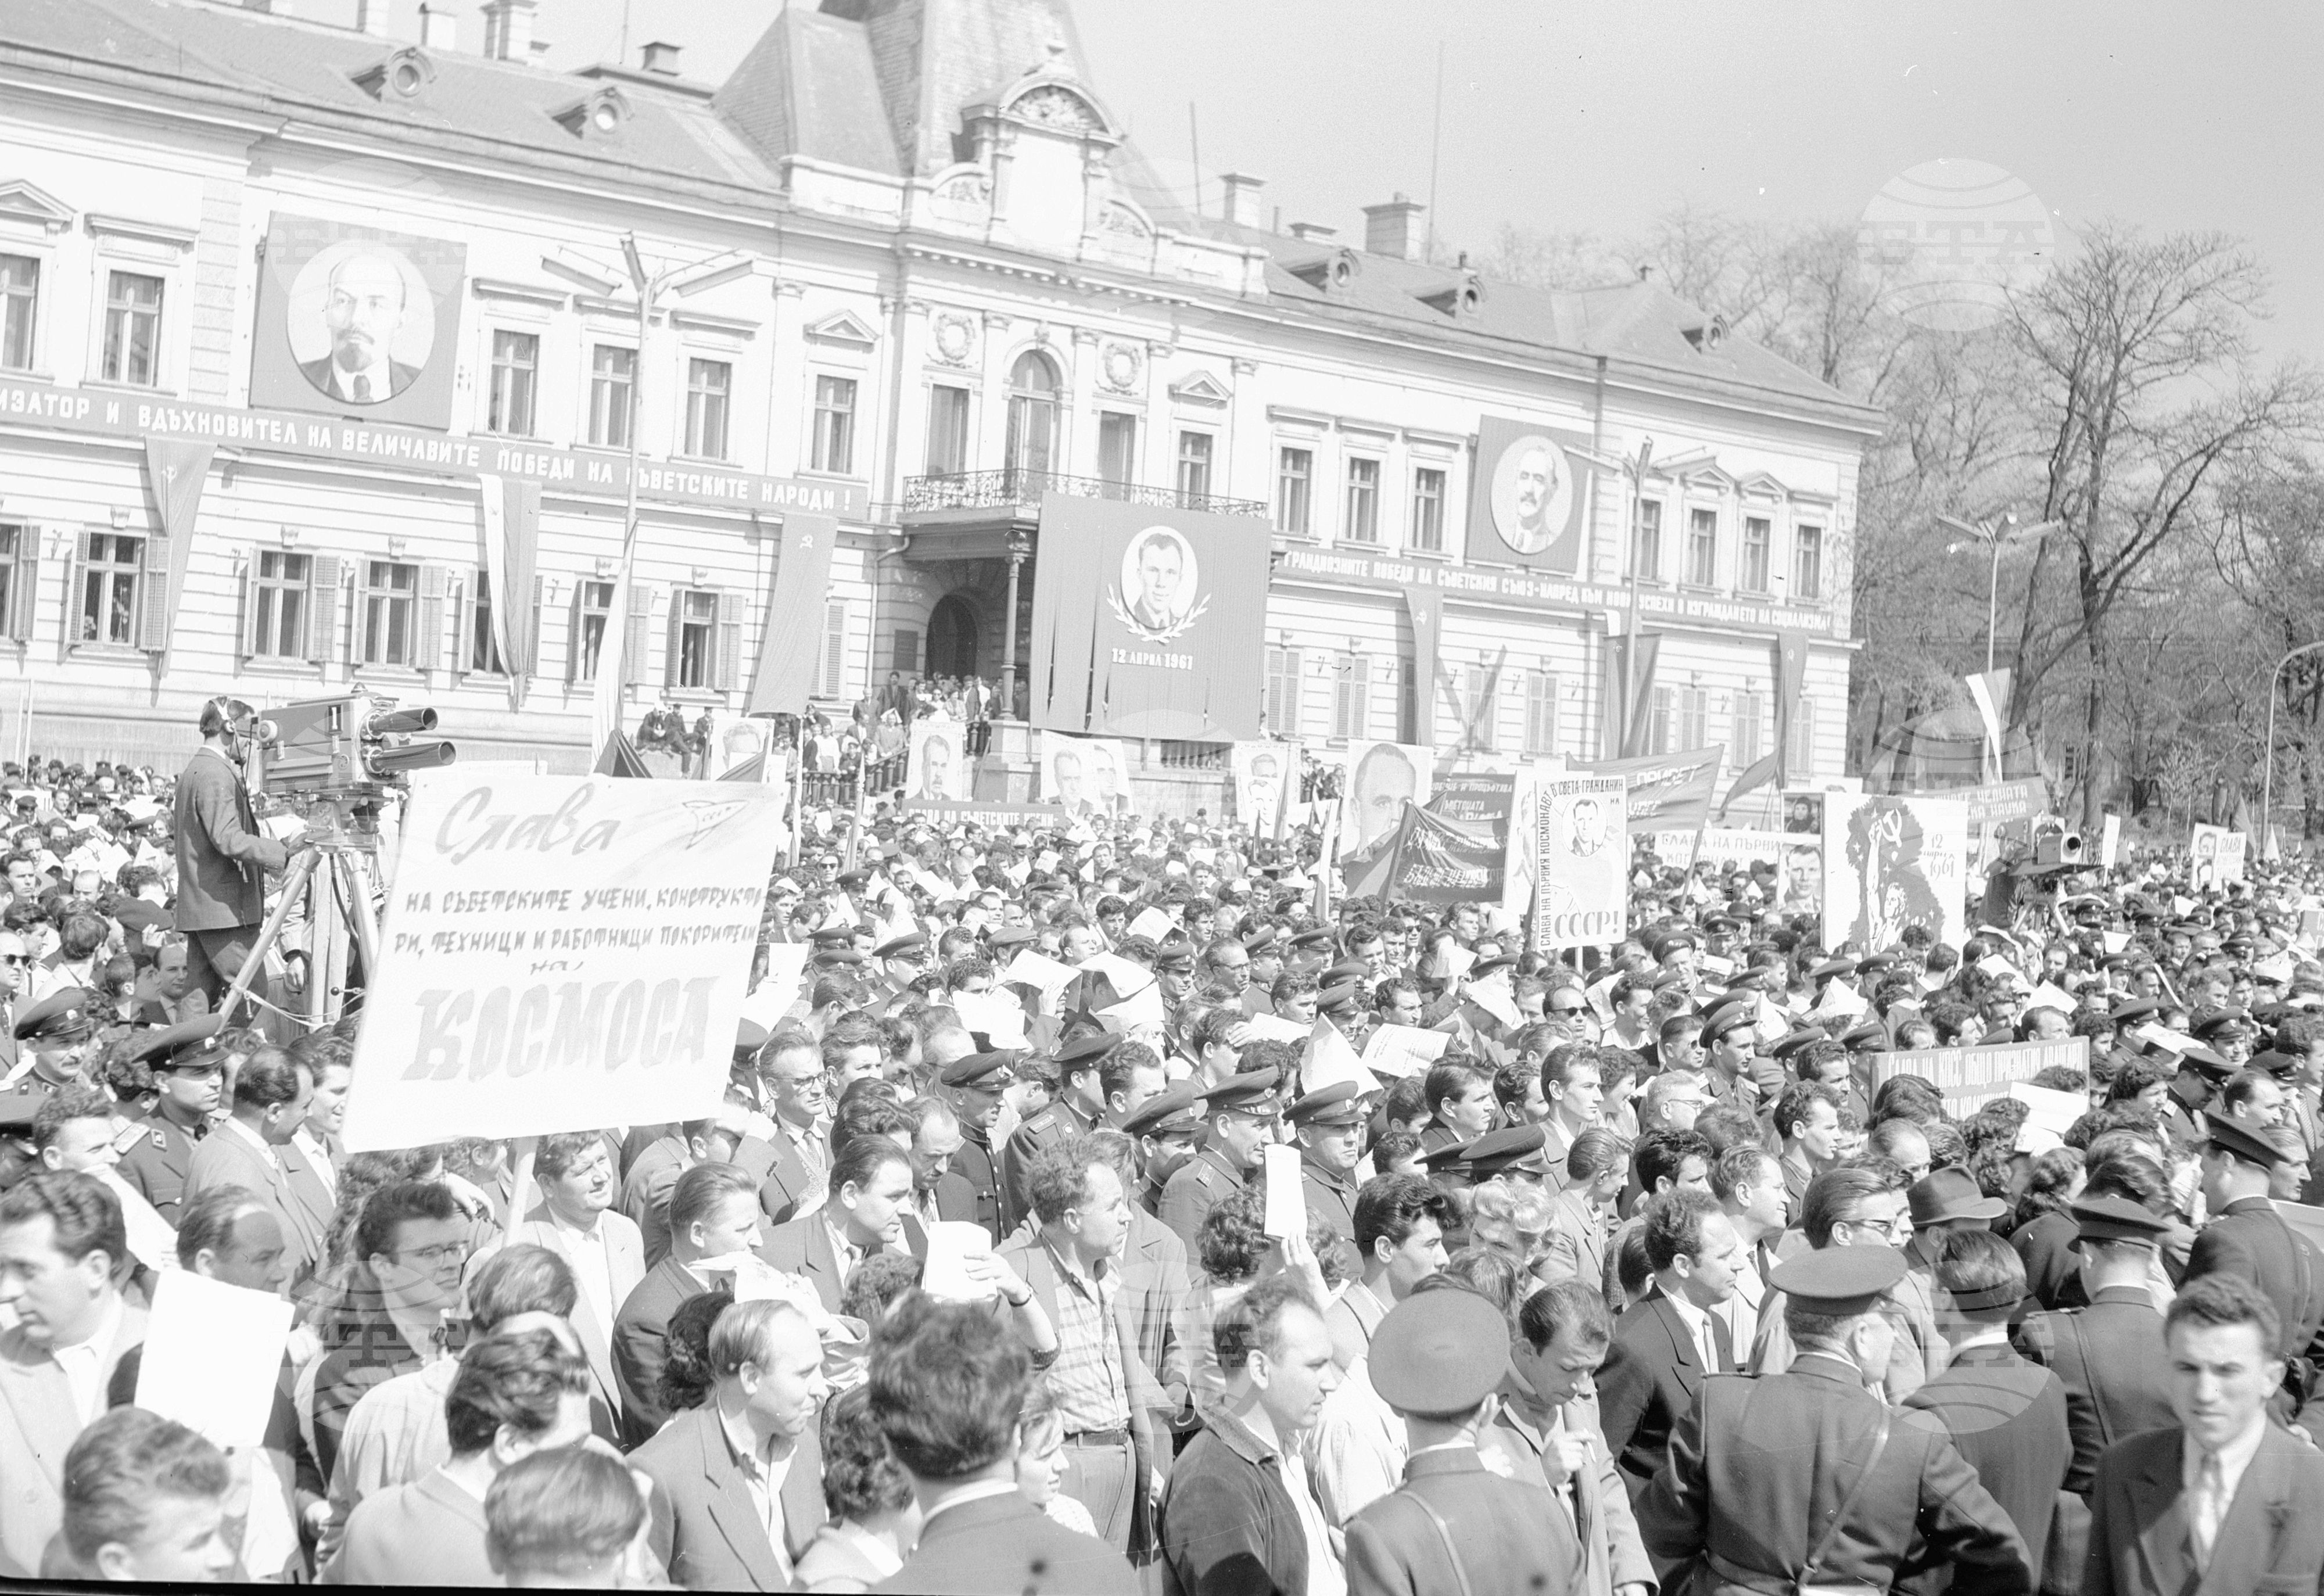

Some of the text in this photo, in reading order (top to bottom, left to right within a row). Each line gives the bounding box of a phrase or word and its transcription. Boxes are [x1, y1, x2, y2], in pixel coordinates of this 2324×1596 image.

[106, 401, 119, 424] И
[138, 405, 297, 444] ВДЪХНОВИТЕЛ
[308, 425, 332, 449] НА
[342, 429, 480, 467] ВЕЛИЧАВИТЕ
[497, 450, 575, 480] ПОБЕДИ
[588, 461, 612, 483] НА
[762, 482, 834, 512] НАРОДИ
[1284, 550, 1368, 577] ГРАНДИОЗНИТЕ
[1373, 561, 1414, 583] ПОБЕДИ
[1418, 567, 1432, 584] НА
[1437, 568, 1497, 592] СЪВЕТСКИЯ
[1581, 587, 1602, 604] КЪМ
[1638, 594, 1674, 613] УСПЕХИ
[1678, 598, 1684, 614] В
[1687, 600, 1755, 623] ИЗГРАЖДАНЕТО
[1759, 609, 1770, 625] НА
[1112, 648, 1193, 670] 12 АПРИЛ 1961
[1550, 783, 1558, 798] В
[436, 783, 621, 865] Слава
[1540, 789, 1553, 855] КОСМОНАВТ
[1713, 837, 1730, 849] НА
[1931, 834, 1943, 849] 12
[1540, 857, 1551, 895] ПЪРВИЯ
[1930, 857, 1954, 881] 1961
[406, 892, 431, 912] НА
[442, 890, 572, 913] СЪВЕТСКИТЕ
[581, 888, 652, 911] УЧЕНИ,
[1541, 898, 1551, 911] НА
[431, 931, 526, 957] ТЕХНИЦИ
[534, 930, 546, 951] И
[551, 928, 653, 952] РАБОТНИЦИ
[660, 924, 756, 946] ПОКОРИТЕЛИ
[1541, 915, 1551, 946] СЛАВА
[1555, 911, 1618, 939] СССР!
[399, 975, 720, 1082] КОСМОСА
[1938, 1050, 1962, 1087] КПСС
[1965, 1052, 1992, 1089] ОБЩО
